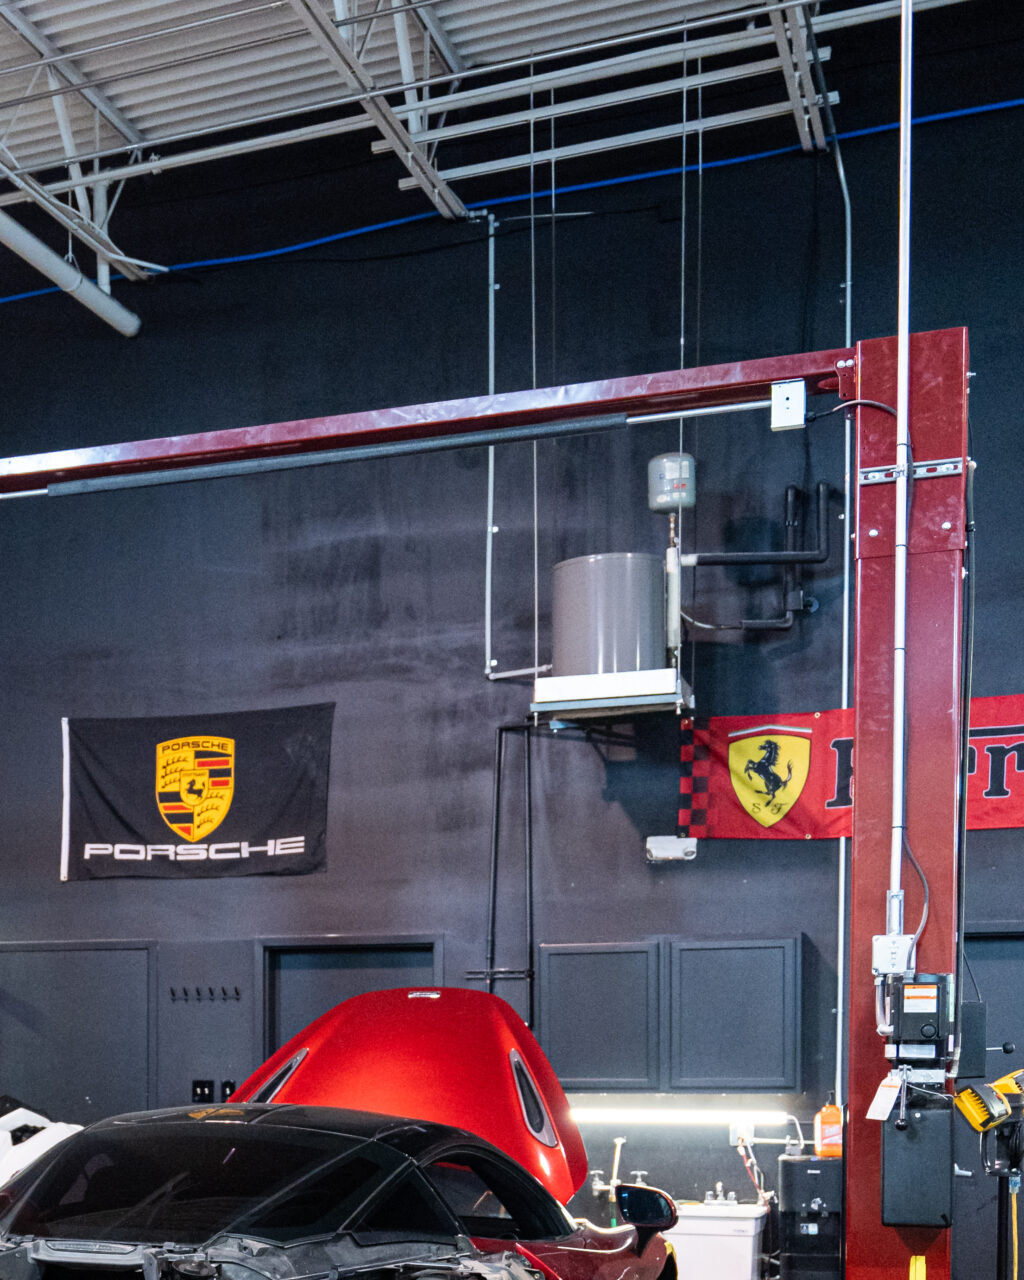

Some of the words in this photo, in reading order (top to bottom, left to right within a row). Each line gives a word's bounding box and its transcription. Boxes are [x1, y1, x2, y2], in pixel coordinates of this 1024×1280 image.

[162, 741, 229, 753] PORSCHE
[752, 803, 761, 814] S
[771, 803, 789, 815] F
[84, 836, 305, 860] PORSCHE
